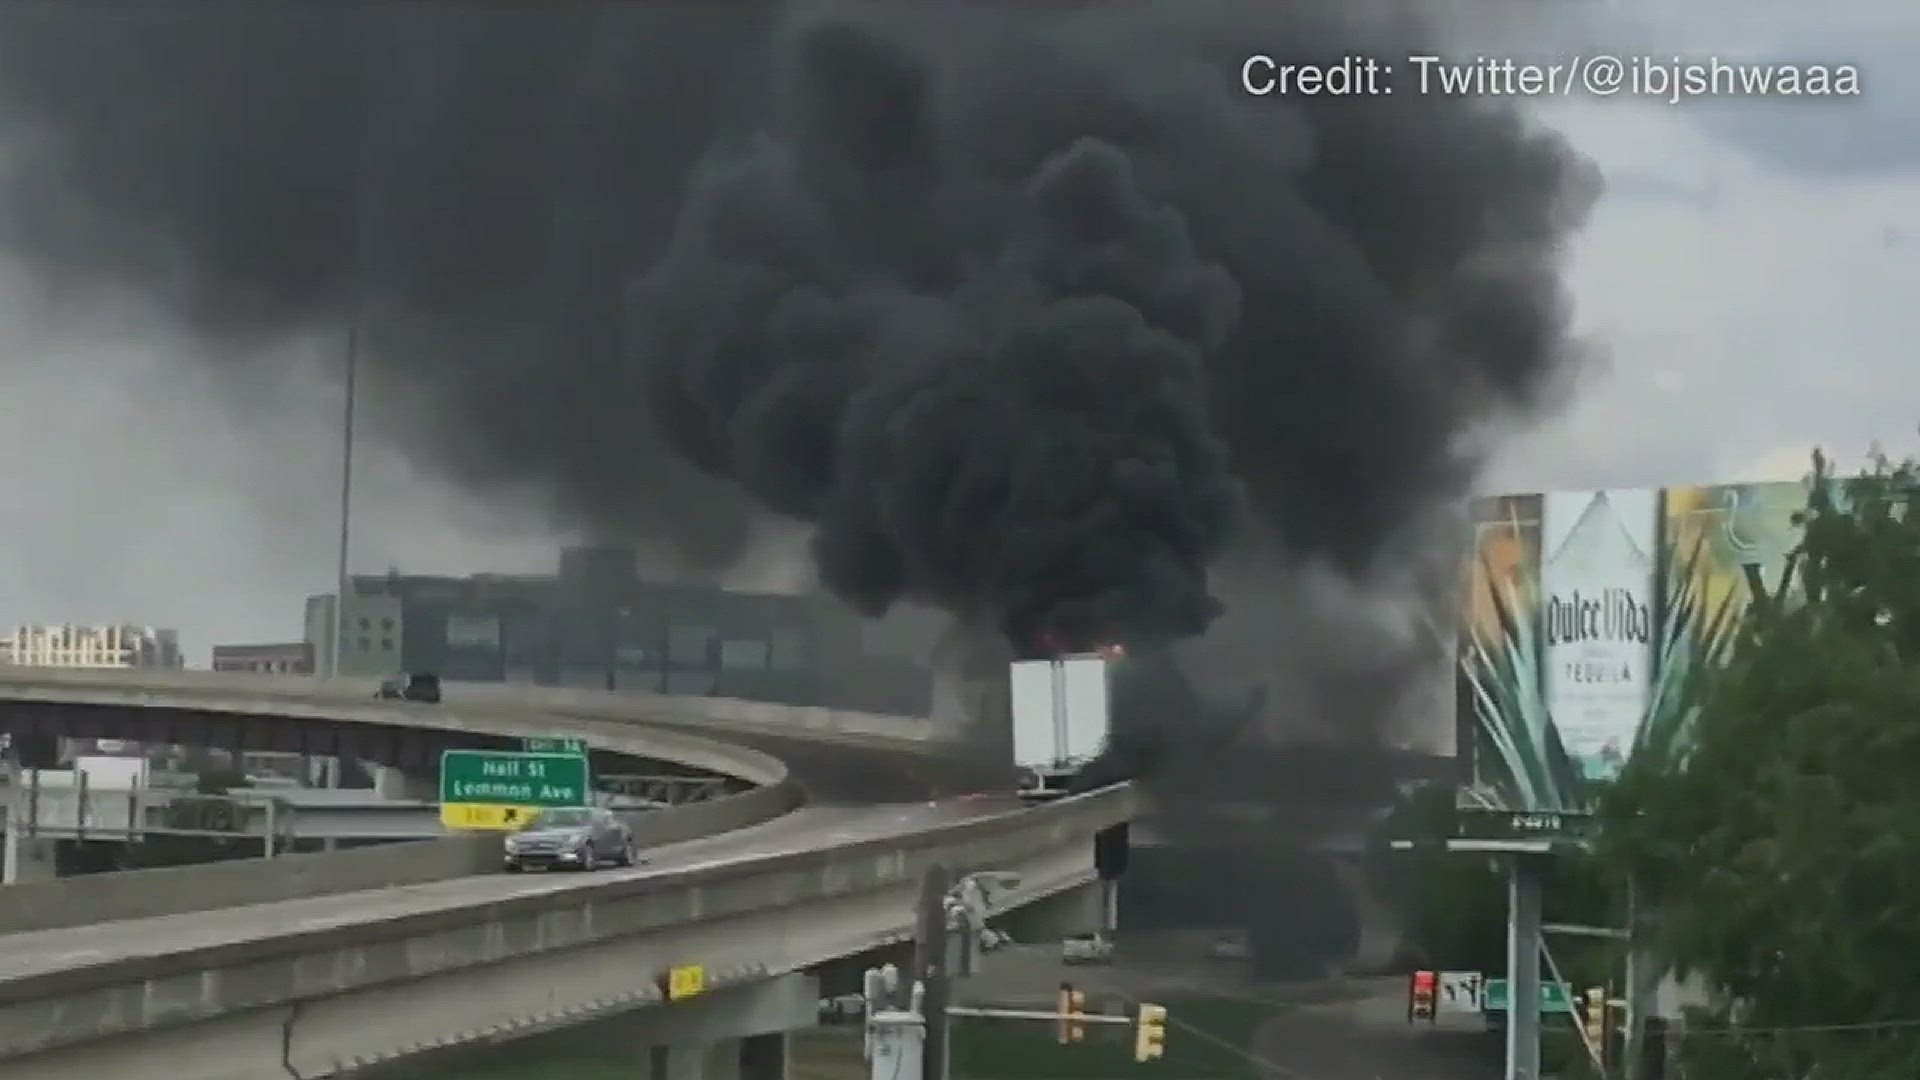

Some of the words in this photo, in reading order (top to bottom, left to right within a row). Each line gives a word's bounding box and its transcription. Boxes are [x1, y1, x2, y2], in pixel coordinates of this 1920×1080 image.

[1548, 588, 1601, 646] Dulce
[1603, 587, 1649, 644] Vida
[1565, 660, 1632, 683] TEQUA
[539, 784, 574, 800] Ave
